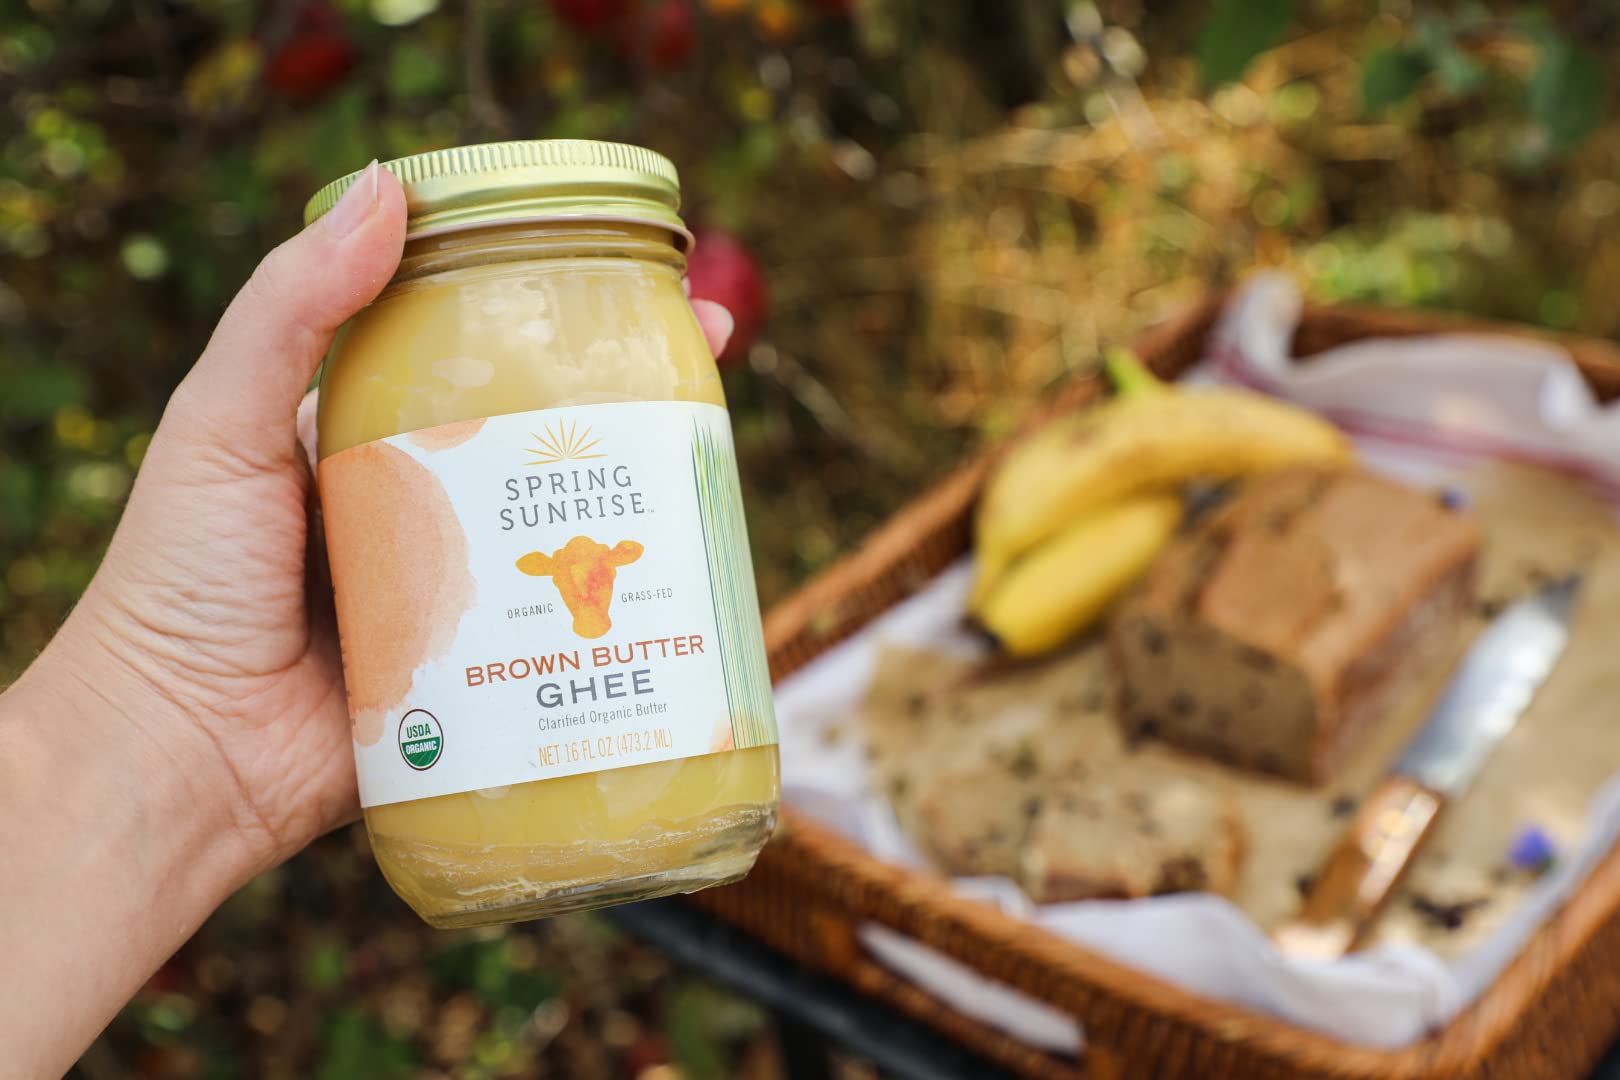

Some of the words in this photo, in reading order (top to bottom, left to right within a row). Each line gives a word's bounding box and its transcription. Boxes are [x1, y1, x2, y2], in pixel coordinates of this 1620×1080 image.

[505, 465, 632, 501] SPRING
[499, 492, 645, 531] SUNRISE
[507, 603, 554, 619] ORGANIC
[621, 588, 673, 603] GRASS-FED
[465, 650, 581, 687] BROWN
[592, 634, 705, 667] BUTTER
[536, 668, 655, 709] GHEE
[406, 722, 431, 739] USDA
[538, 711, 586, 731] Clarified
[590, 706, 633, 724] Organic
[635, 701, 668, 716] Butter
[405, 740, 437, 755] ORGANIC
[538, 744, 560, 768] NET
[565, 742, 579, 763] 16
[582, 740, 597, 760] FL
[598, 736, 614, 758] OZ
[616, 732, 650, 756] (473.2
[653, 728, 673, 751] ML)
